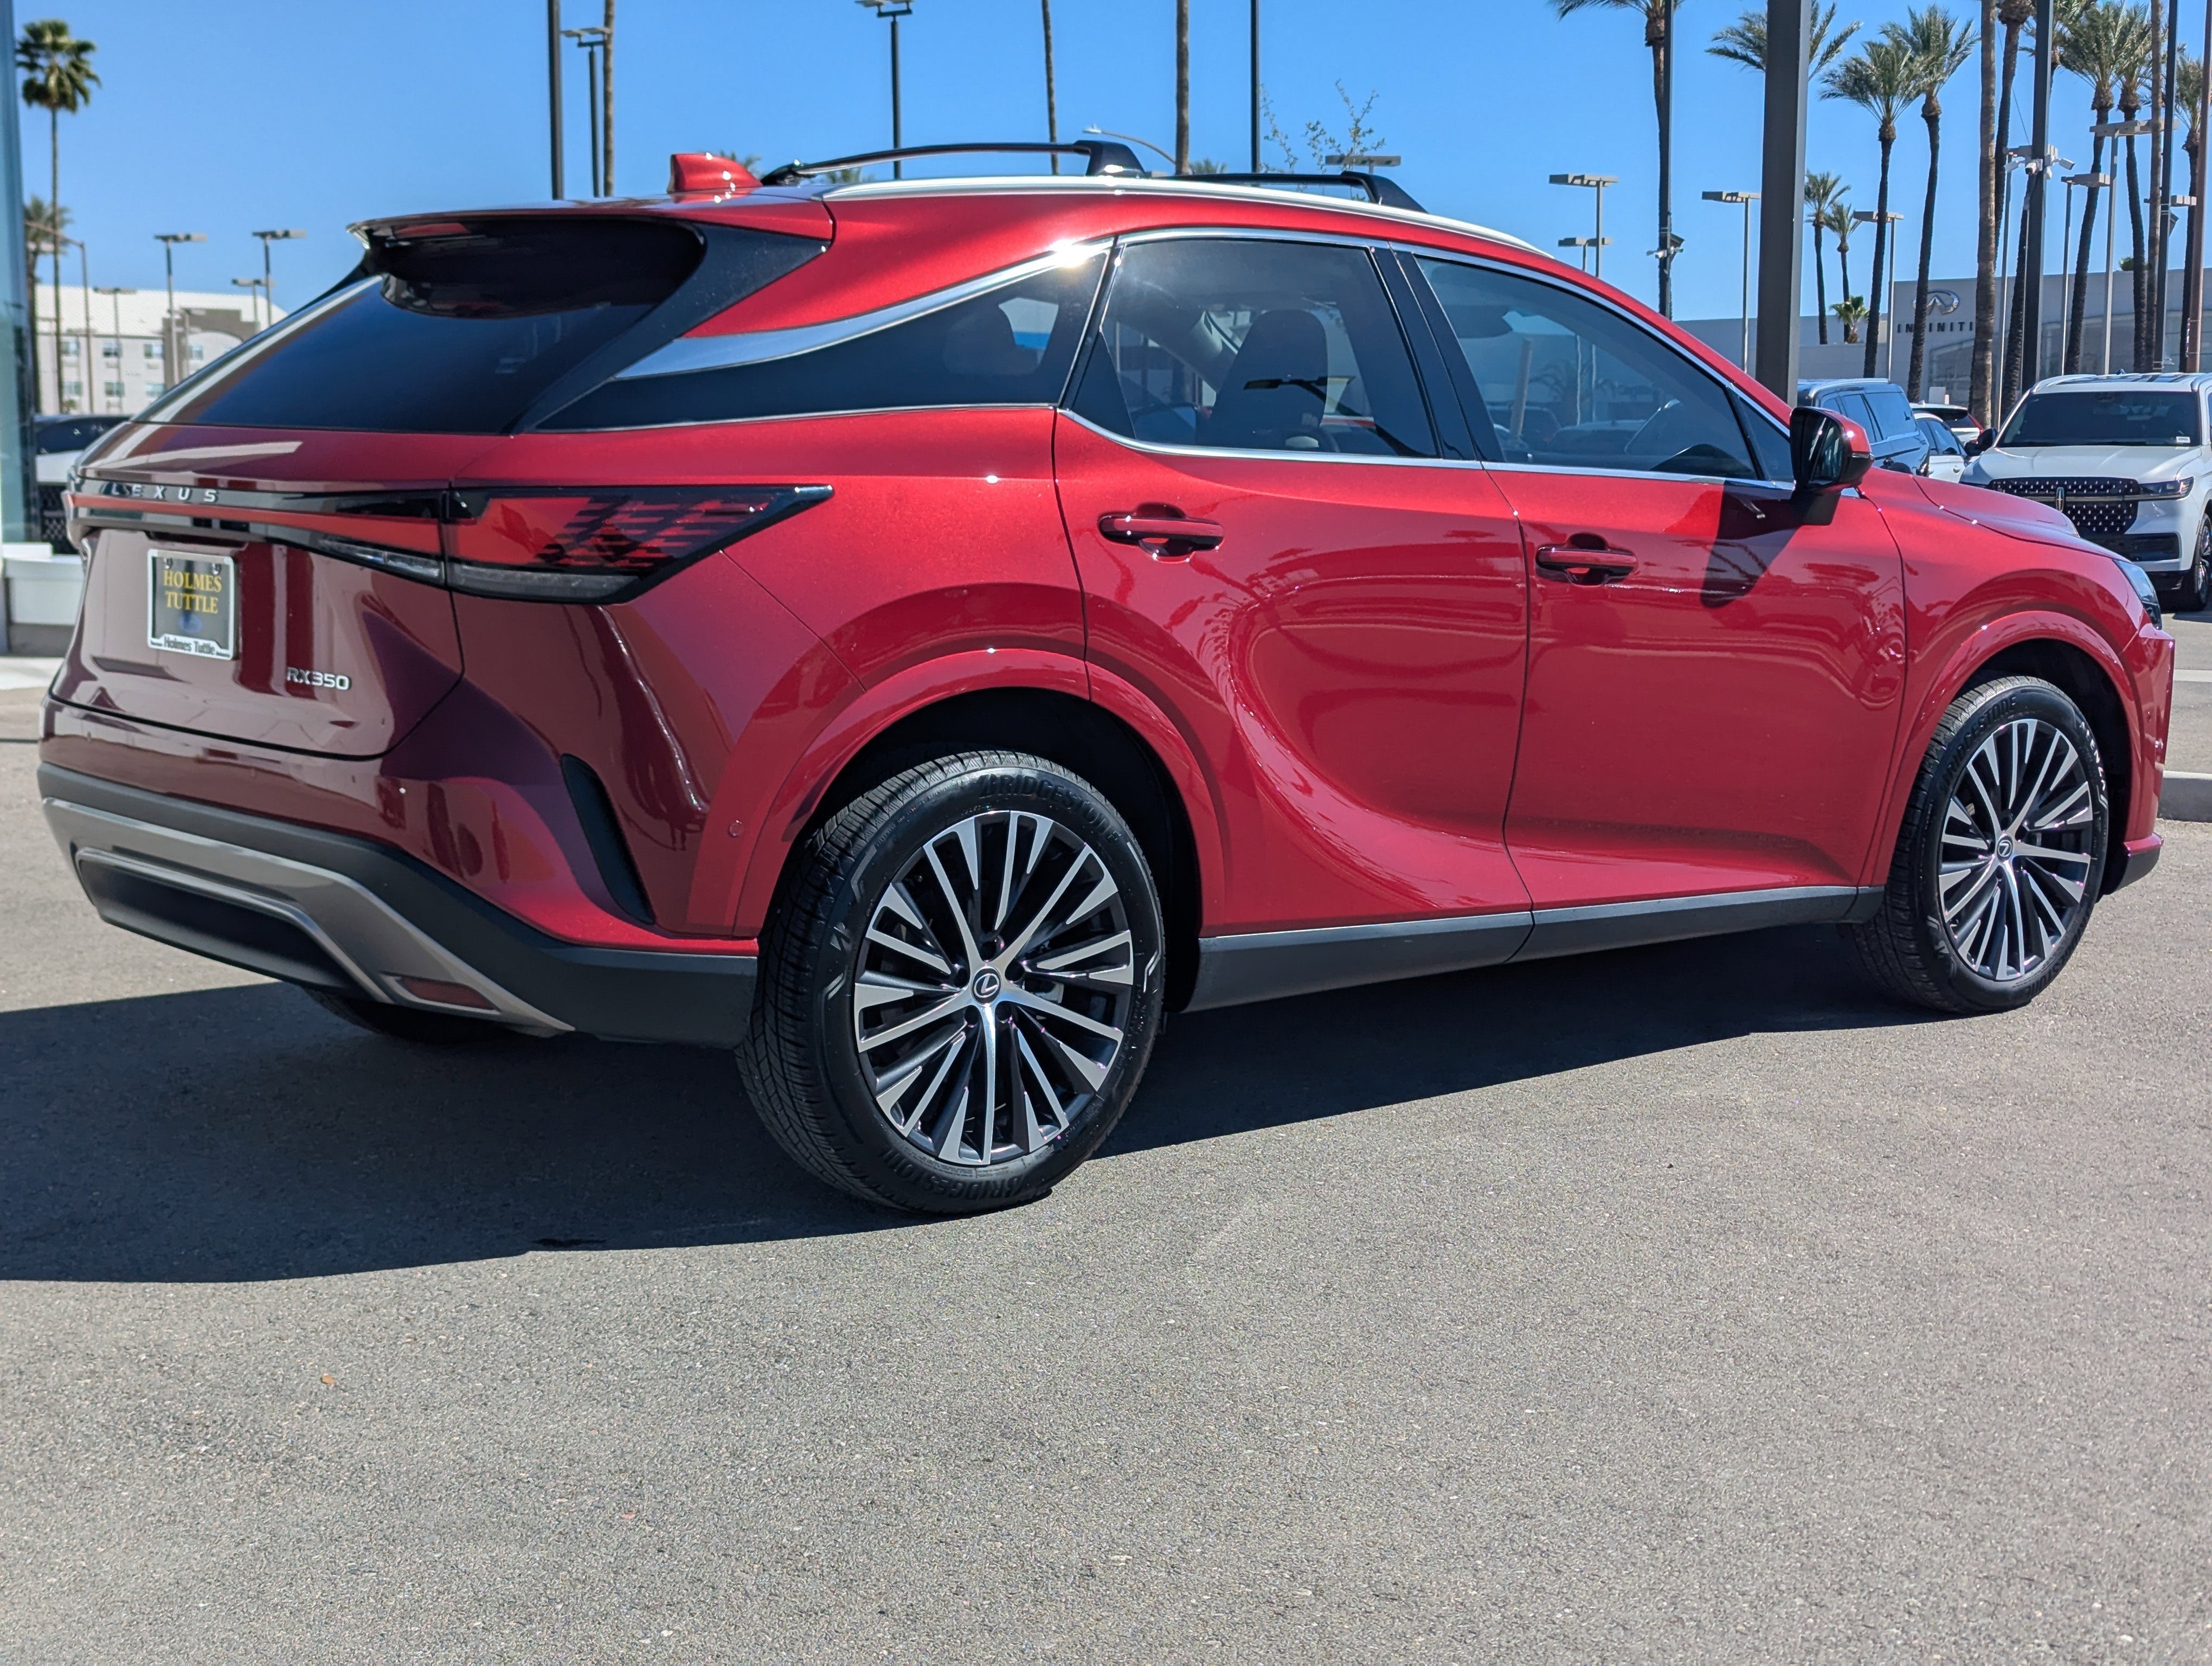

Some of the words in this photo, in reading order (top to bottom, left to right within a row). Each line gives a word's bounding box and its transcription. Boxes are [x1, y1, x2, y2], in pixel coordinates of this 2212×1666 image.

[1897, 322, 1973, 333] ININITI
[111, 482, 217, 502] LEXUS
[164, 569, 222, 592] HOLMES
[165, 591, 218, 613] TUTTLE
[286, 667, 350, 690] RX350
[977, 773, 1122, 842] BRIDGESTONE
